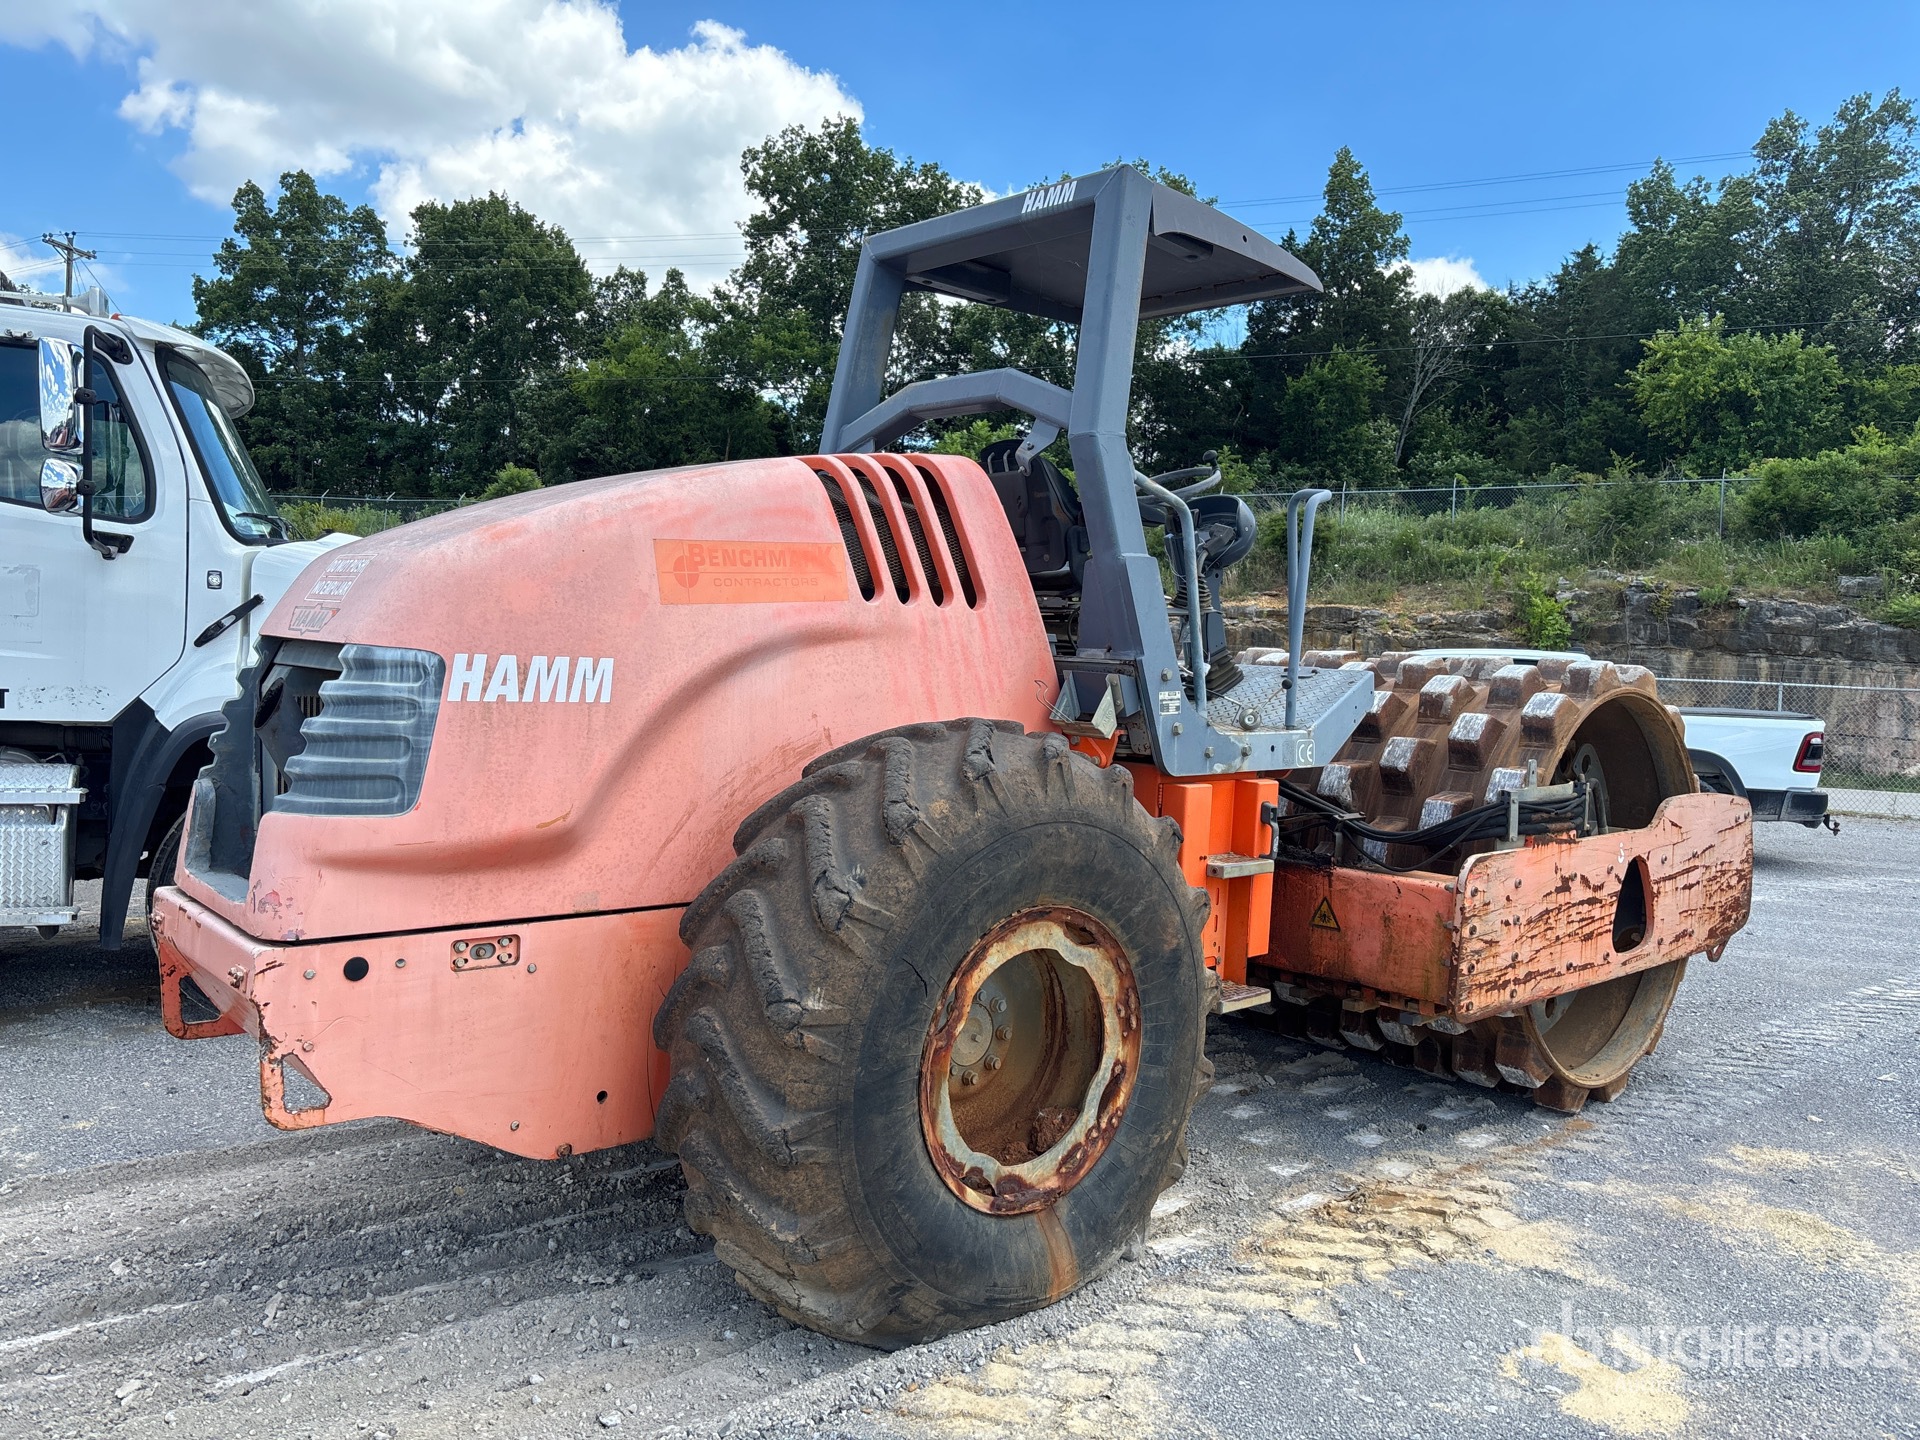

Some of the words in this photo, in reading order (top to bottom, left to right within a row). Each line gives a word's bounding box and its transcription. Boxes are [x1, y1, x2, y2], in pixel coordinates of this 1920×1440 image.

[1021, 180, 1077, 214] HAMM
[713, 577, 819, 587] CONTRACTORS
[292, 609, 330, 629] HAMM
[447, 653, 614, 703] HAMM
[1298, 743, 1313, 763] CE
